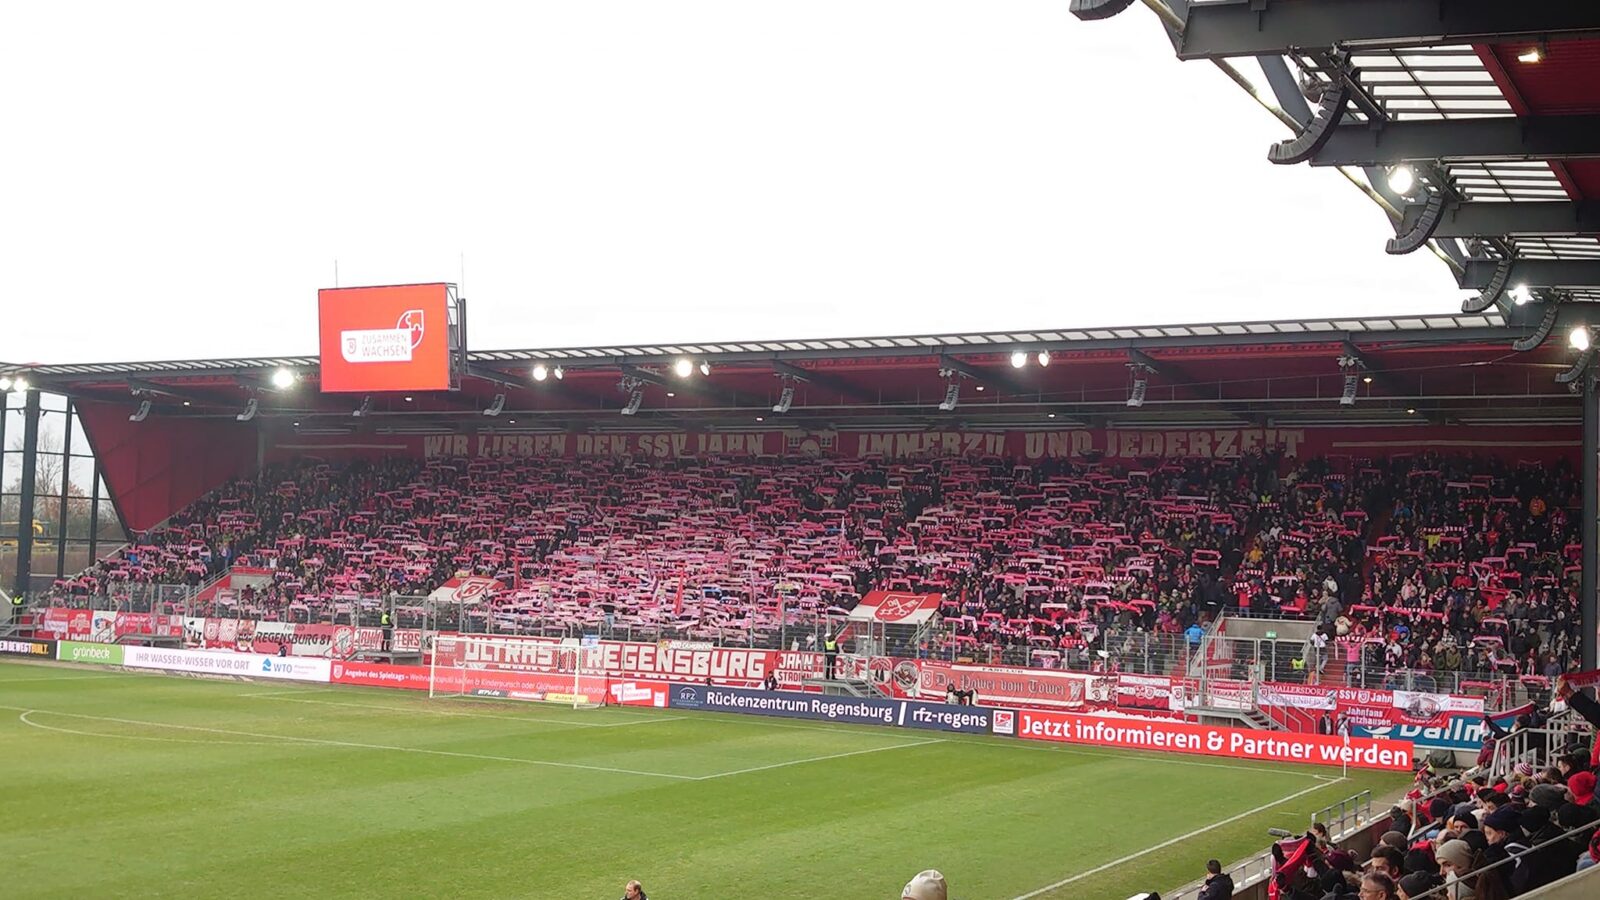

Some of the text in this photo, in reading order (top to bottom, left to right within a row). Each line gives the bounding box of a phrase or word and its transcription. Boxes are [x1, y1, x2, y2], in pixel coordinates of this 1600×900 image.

[362, 334, 407, 345] ZUSAMMEN
[361, 345, 408, 357] WACHSEN
[424, 434, 764, 457] WIR LIEBEN DEN SSV JAHN
[858, 430, 1304, 458] IMMERZU UND JEDERZEIT
[255, 631, 319, 646] REGENSBURG
[320, 634, 332, 645] 81
[73, 646, 110, 660] grünbeck
[136, 652, 250, 670] IHR WASSER-WISSER VOR ORT
[465, 637, 553, 665] ULTRAS
[586, 644, 766, 679] REGENSBURG
[779, 653, 813, 670] JAHN
[273, 663, 292, 673] WTO
[345, 669, 368, 679] Angebot
[379, 672, 404, 681] Spieltags
[1000, 678, 1024, 692] vom
[1028, 679, 1065, 695] Tower
[1339, 690, 1392, 703] SSV Jahn
[707, 691, 893, 722] Rückenzentrum Regensburg
[1346, 706, 1383, 718] Jahnfans
[912, 707, 988, 728] rfz-regens
[1022, 716, 1408, 767] Jetzt informieren & Partner werden
